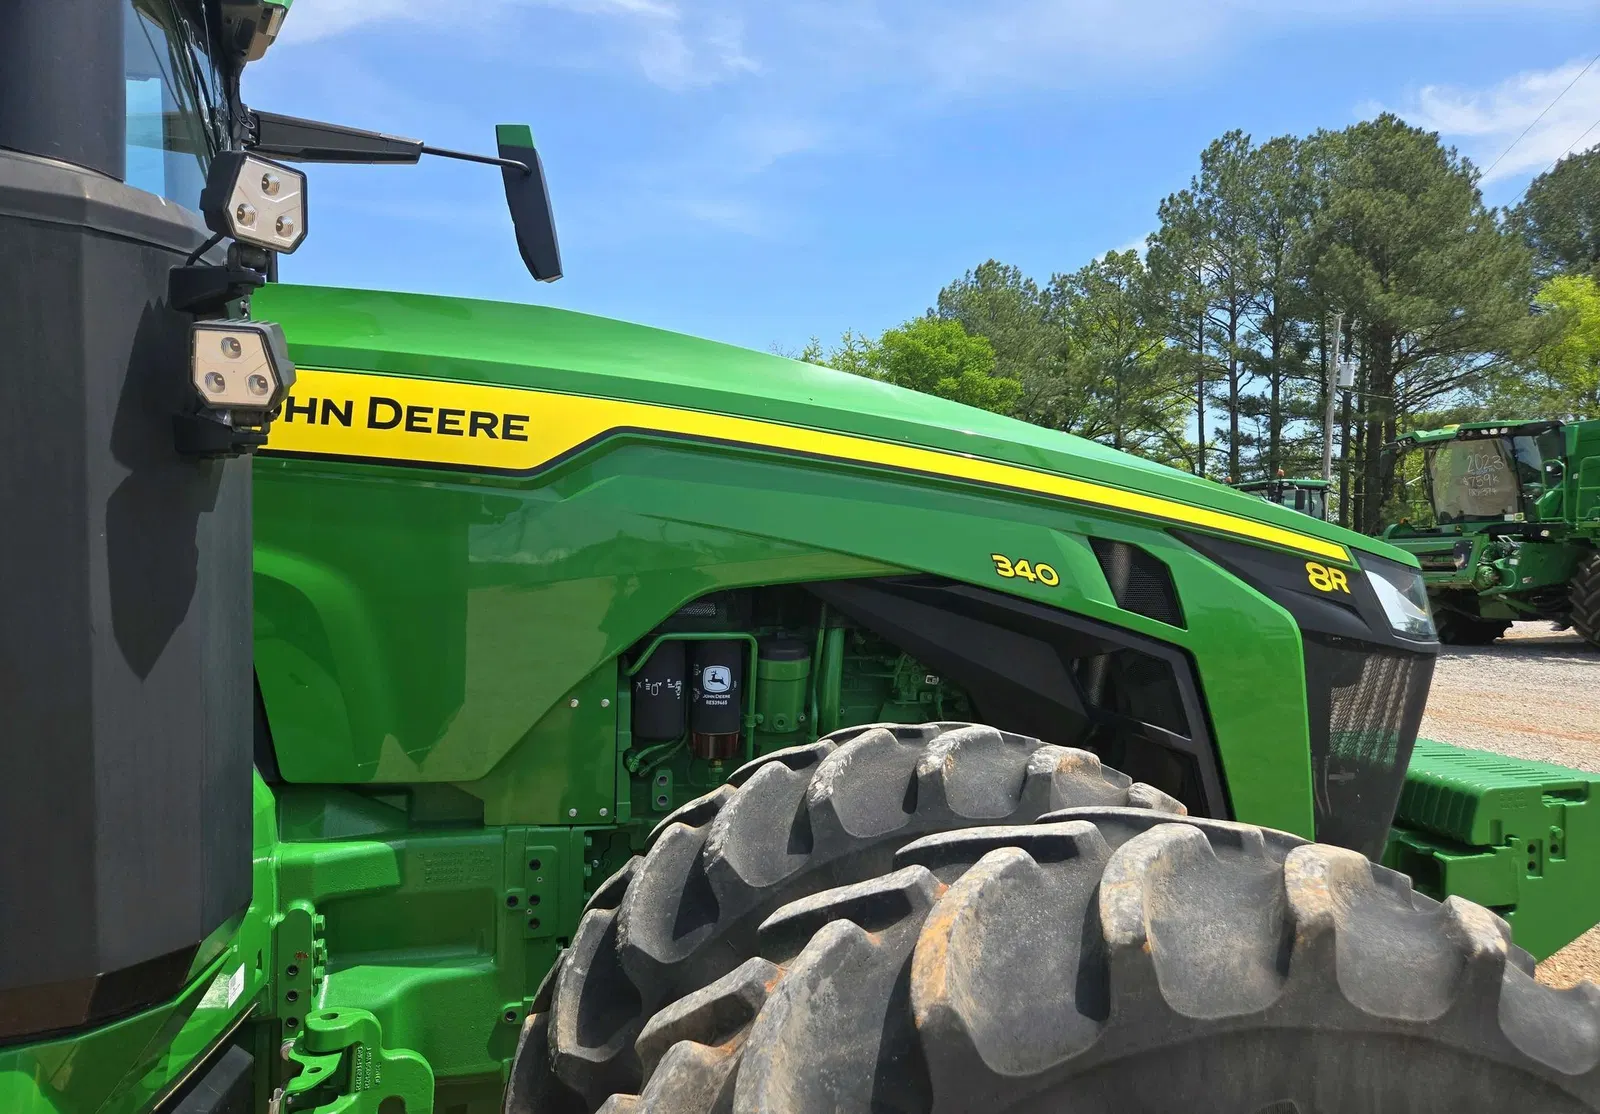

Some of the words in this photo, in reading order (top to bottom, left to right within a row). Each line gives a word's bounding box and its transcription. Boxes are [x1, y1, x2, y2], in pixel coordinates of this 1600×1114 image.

[274, 396, 353, 427] HN
[367, 396, 530, 442] DEERE
[1466, 453, 1505, 473] 2023
[991, 553, 1061, 587] 340
[1304, 561, 1352, 594] 8R
